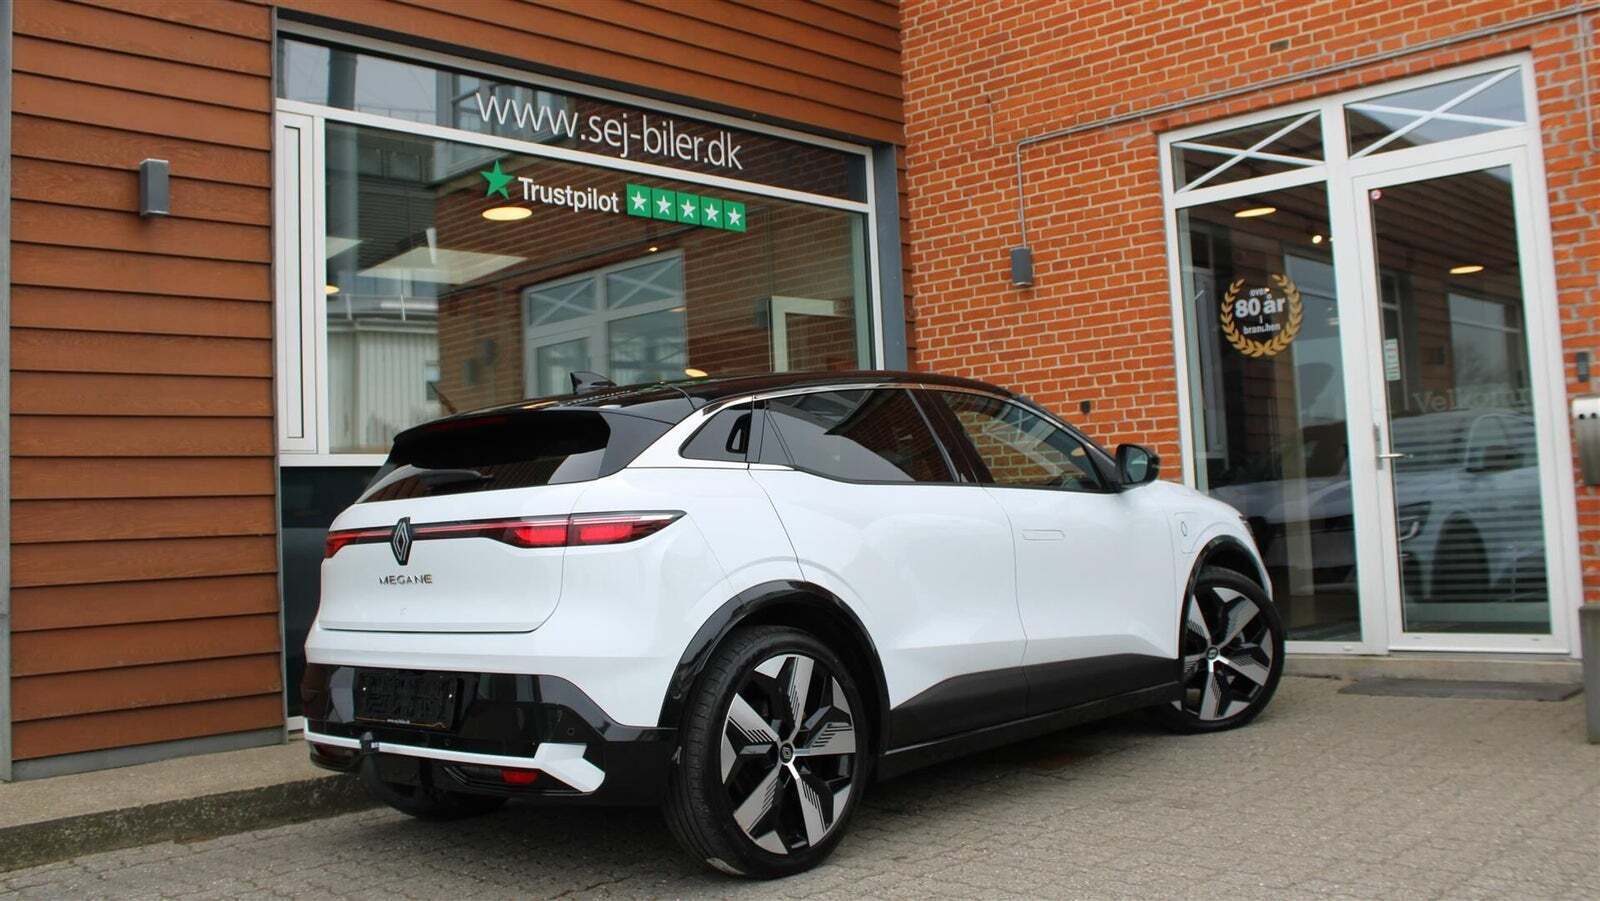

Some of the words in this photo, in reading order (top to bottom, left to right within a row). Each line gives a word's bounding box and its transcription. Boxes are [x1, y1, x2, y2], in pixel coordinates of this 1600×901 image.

[475, 92, 743, 170] www.sej-biler.dk
[518, 176, 620, 213] Trustpilot
[1235, 298, 1261, 318] 80
[1263, 294, 1285, 313] år
[378, 574, 433, 585] MEGANE
